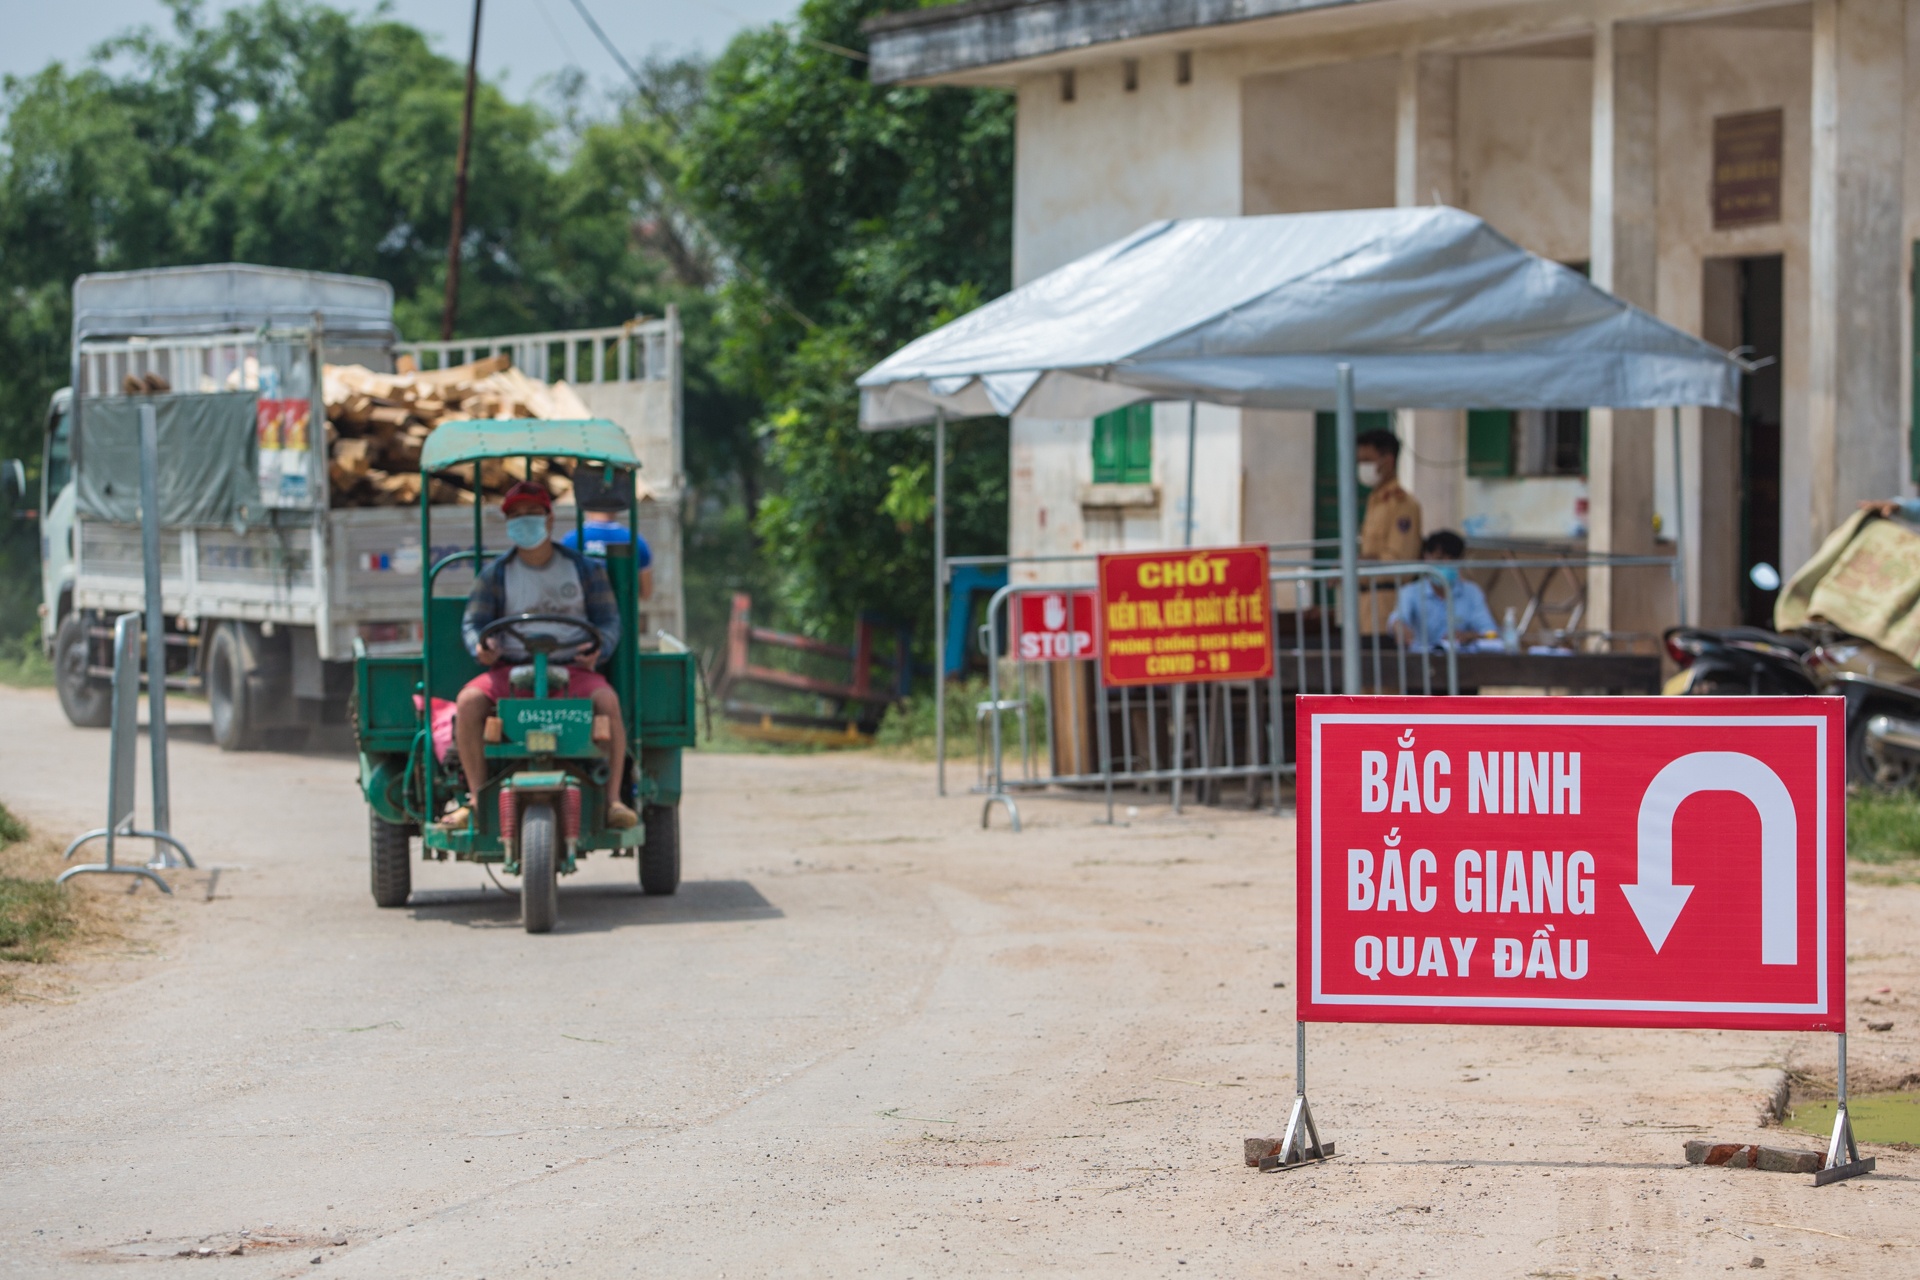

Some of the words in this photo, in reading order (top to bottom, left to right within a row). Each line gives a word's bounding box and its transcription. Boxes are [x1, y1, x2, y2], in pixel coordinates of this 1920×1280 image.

[1138, 551, 1229, 588] CHỐT
[1020, 631, 1090, 658] STOP
[1146, 653, 1195, 675] COVID
[1209, 651, 1230, 672] 19
[1361, 729, 1451, 814] BẮC
[1469, 751, 1580, 814] NINH
[1348, 827, 1437, 912] BẮC
[1455, 850, 1594, 914] GIANG
[1355, 935, 1477, 981] QUAY
[1492, 924, 1588, 980] ĐẦU
